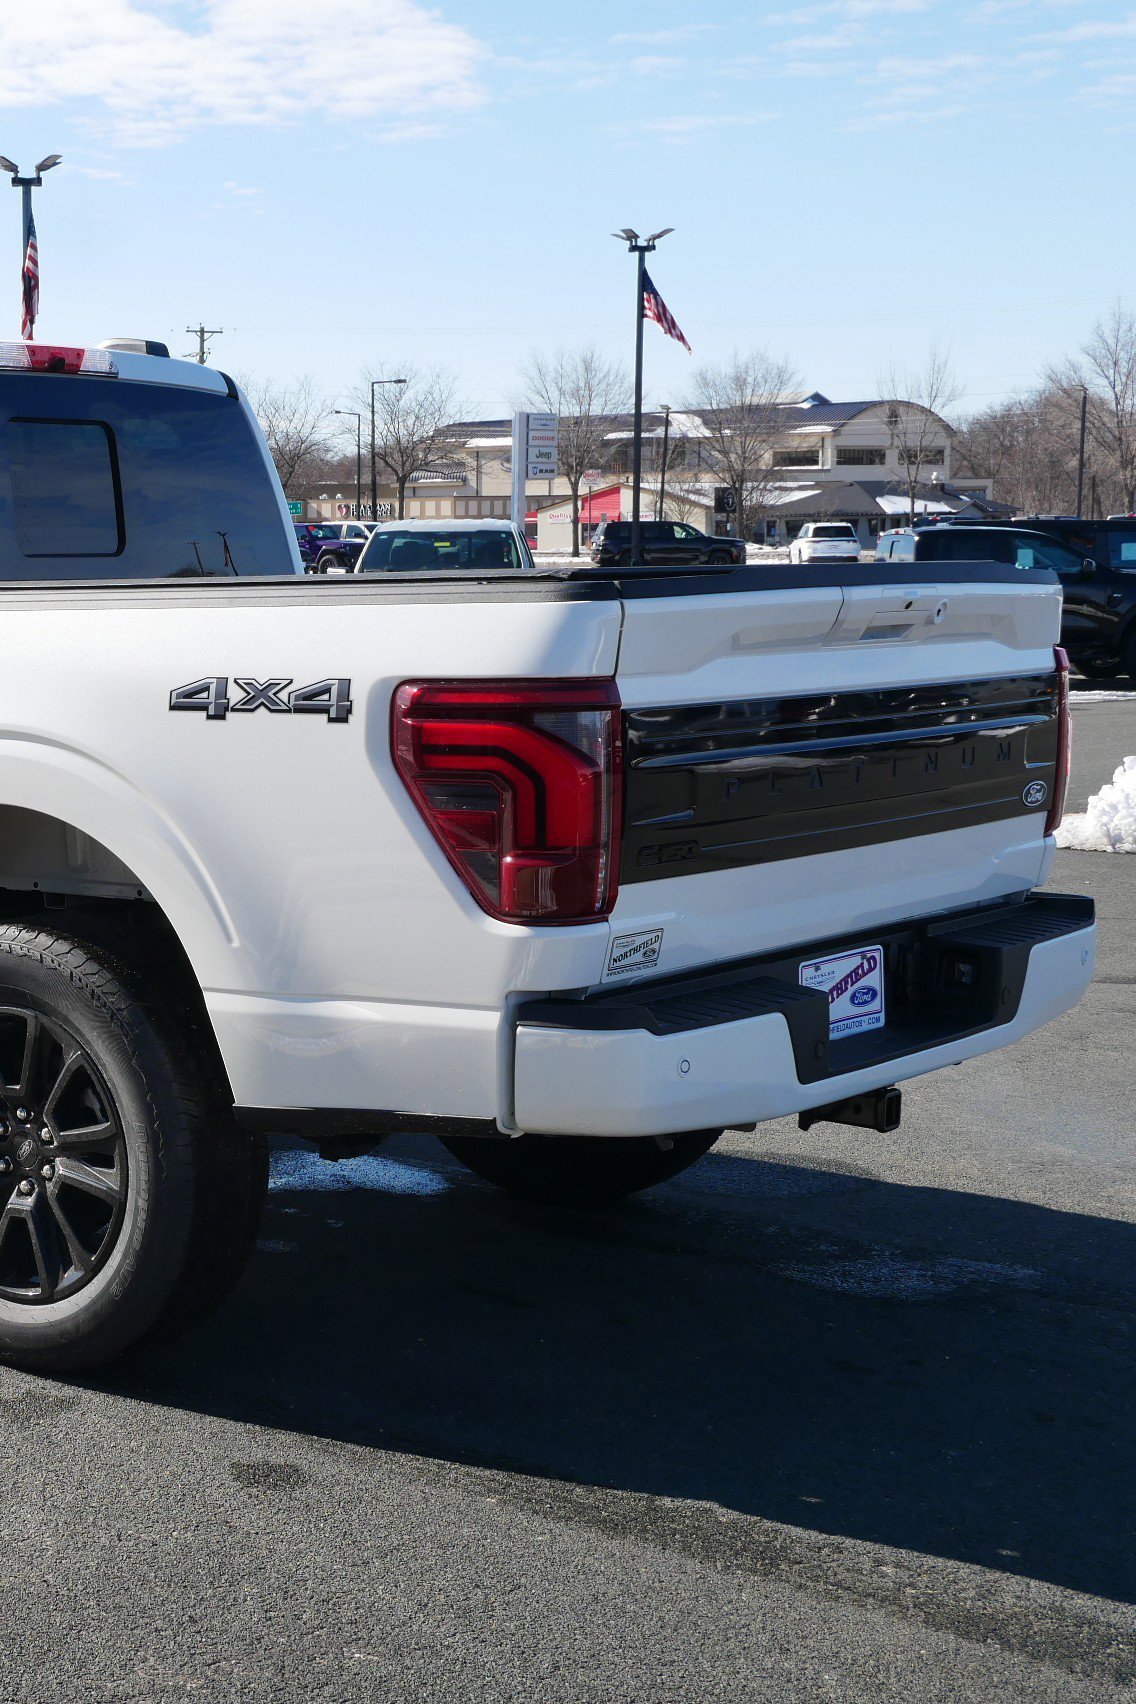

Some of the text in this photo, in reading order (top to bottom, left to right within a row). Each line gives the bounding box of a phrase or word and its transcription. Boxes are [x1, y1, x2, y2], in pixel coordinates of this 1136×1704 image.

[535, 449, 552, 460] Jeep
[724, 741, 1012, 800] PLATINUM
[1027, 785, 1044, 802] Ford
[612, 934, 660, 966] NORTHFIELD
[805, 970, 835, 982] CHRYSLER
[828, 954, 878, 1005] THFIELD
[854, 988, 872, 1004] Ford
